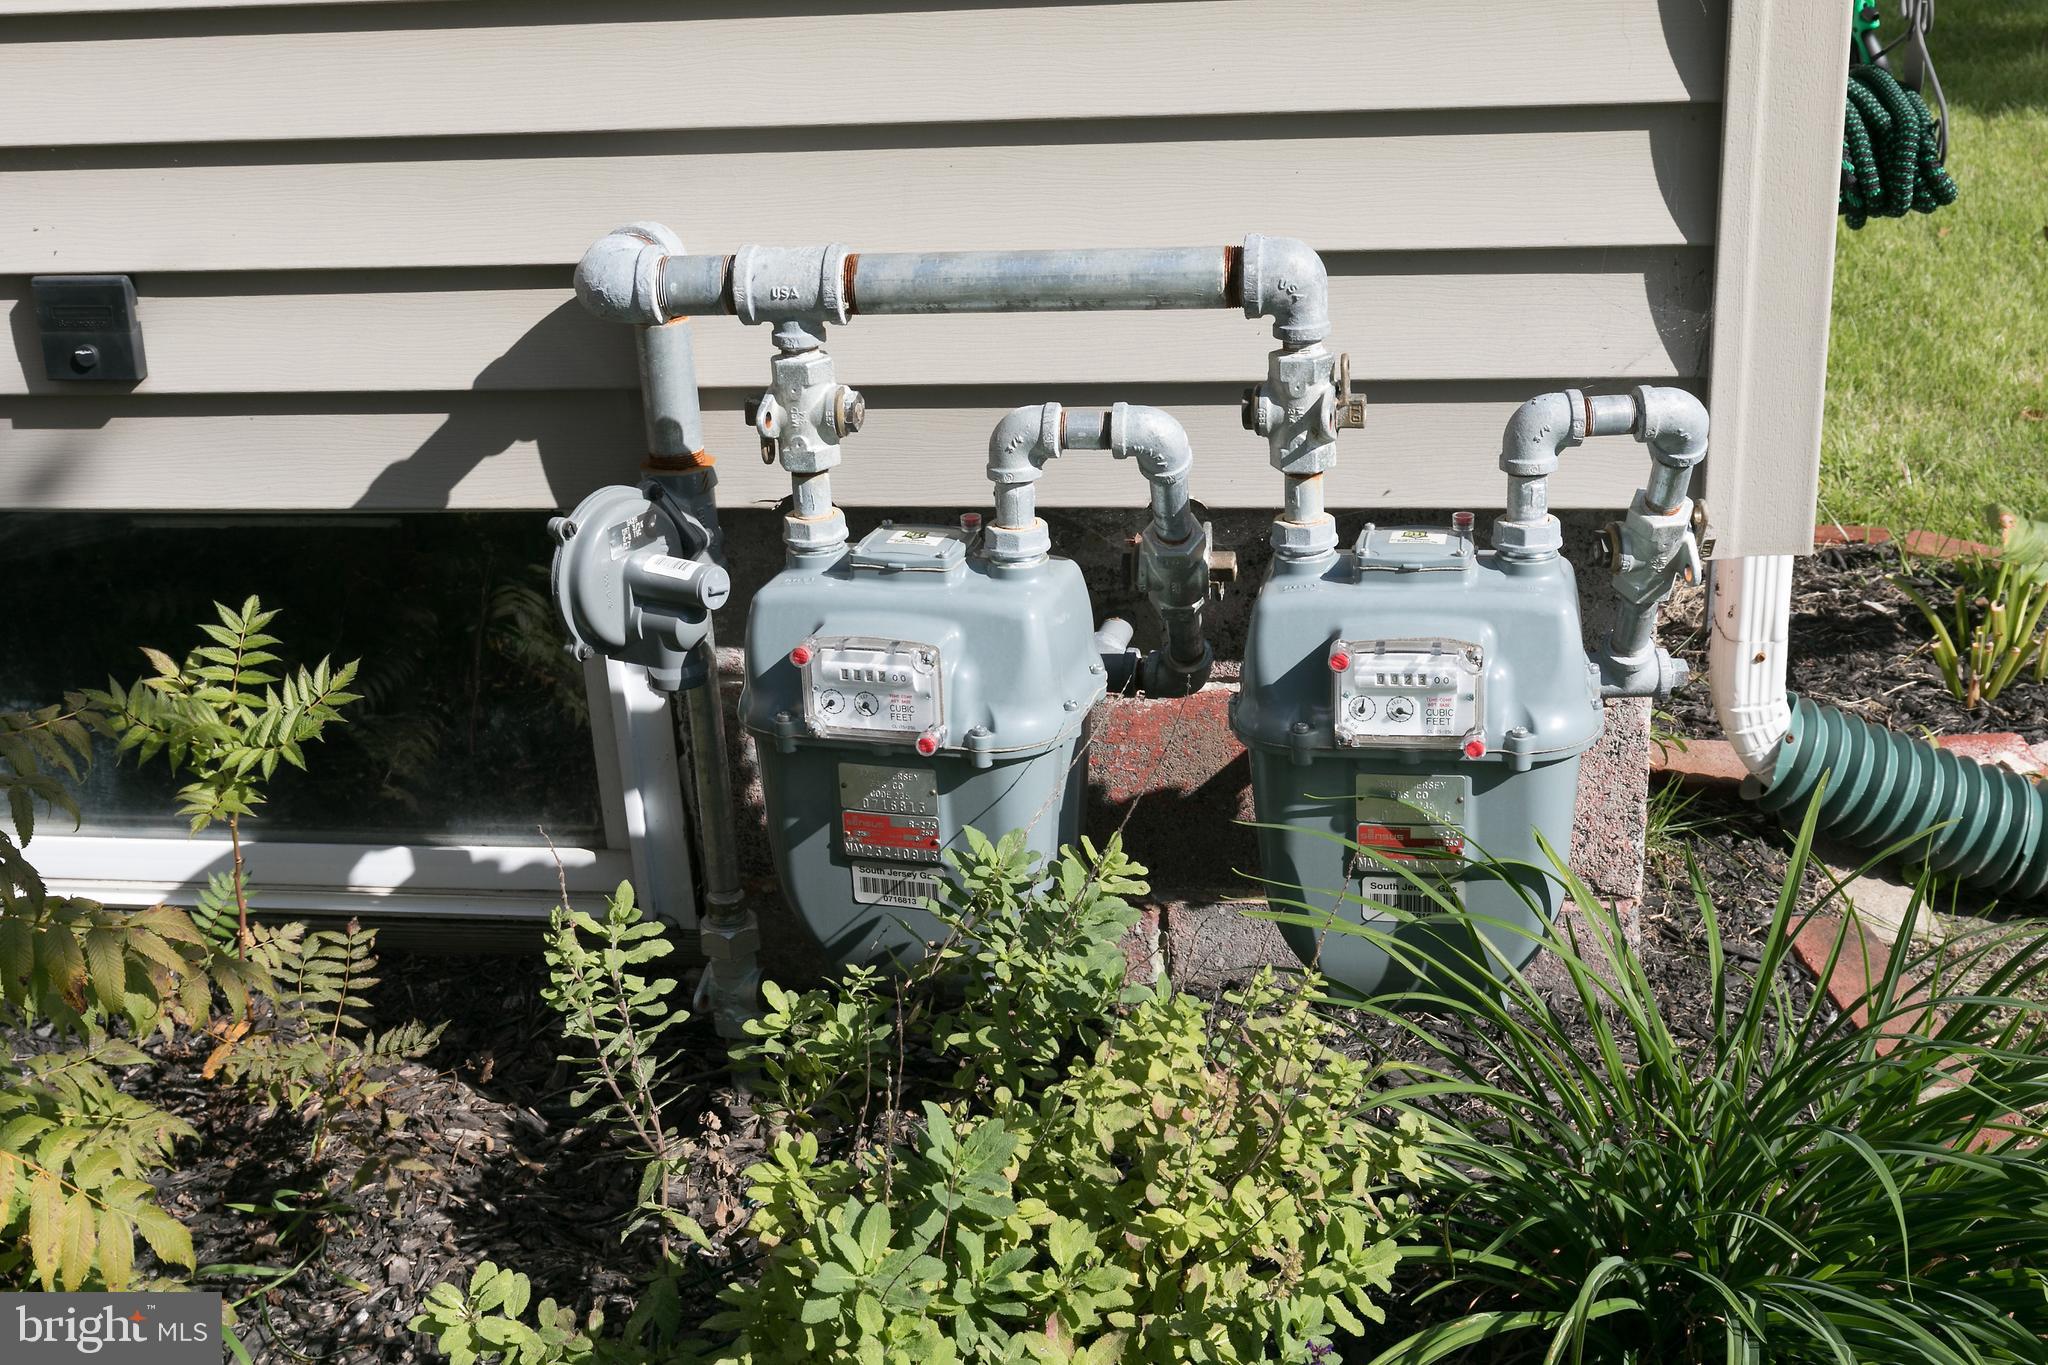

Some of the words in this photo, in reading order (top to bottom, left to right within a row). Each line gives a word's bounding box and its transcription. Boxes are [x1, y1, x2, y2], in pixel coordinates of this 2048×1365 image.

[770, 286, 799, 301] USA
[889, 704, 915, 713] CUBIC
[1426, 708, 1454, 717] CUBIC
[890, 713, 913, 722] FEET
[1426, 717, 1451, 726] FEET
[858, 865, 885, 875] South
[887, 869, 917, 880] Jersey
[919, 871, 934, 880] Ga
[1370, 882, 1399, 890] South
[883, 895, 917, 905] 0716813
